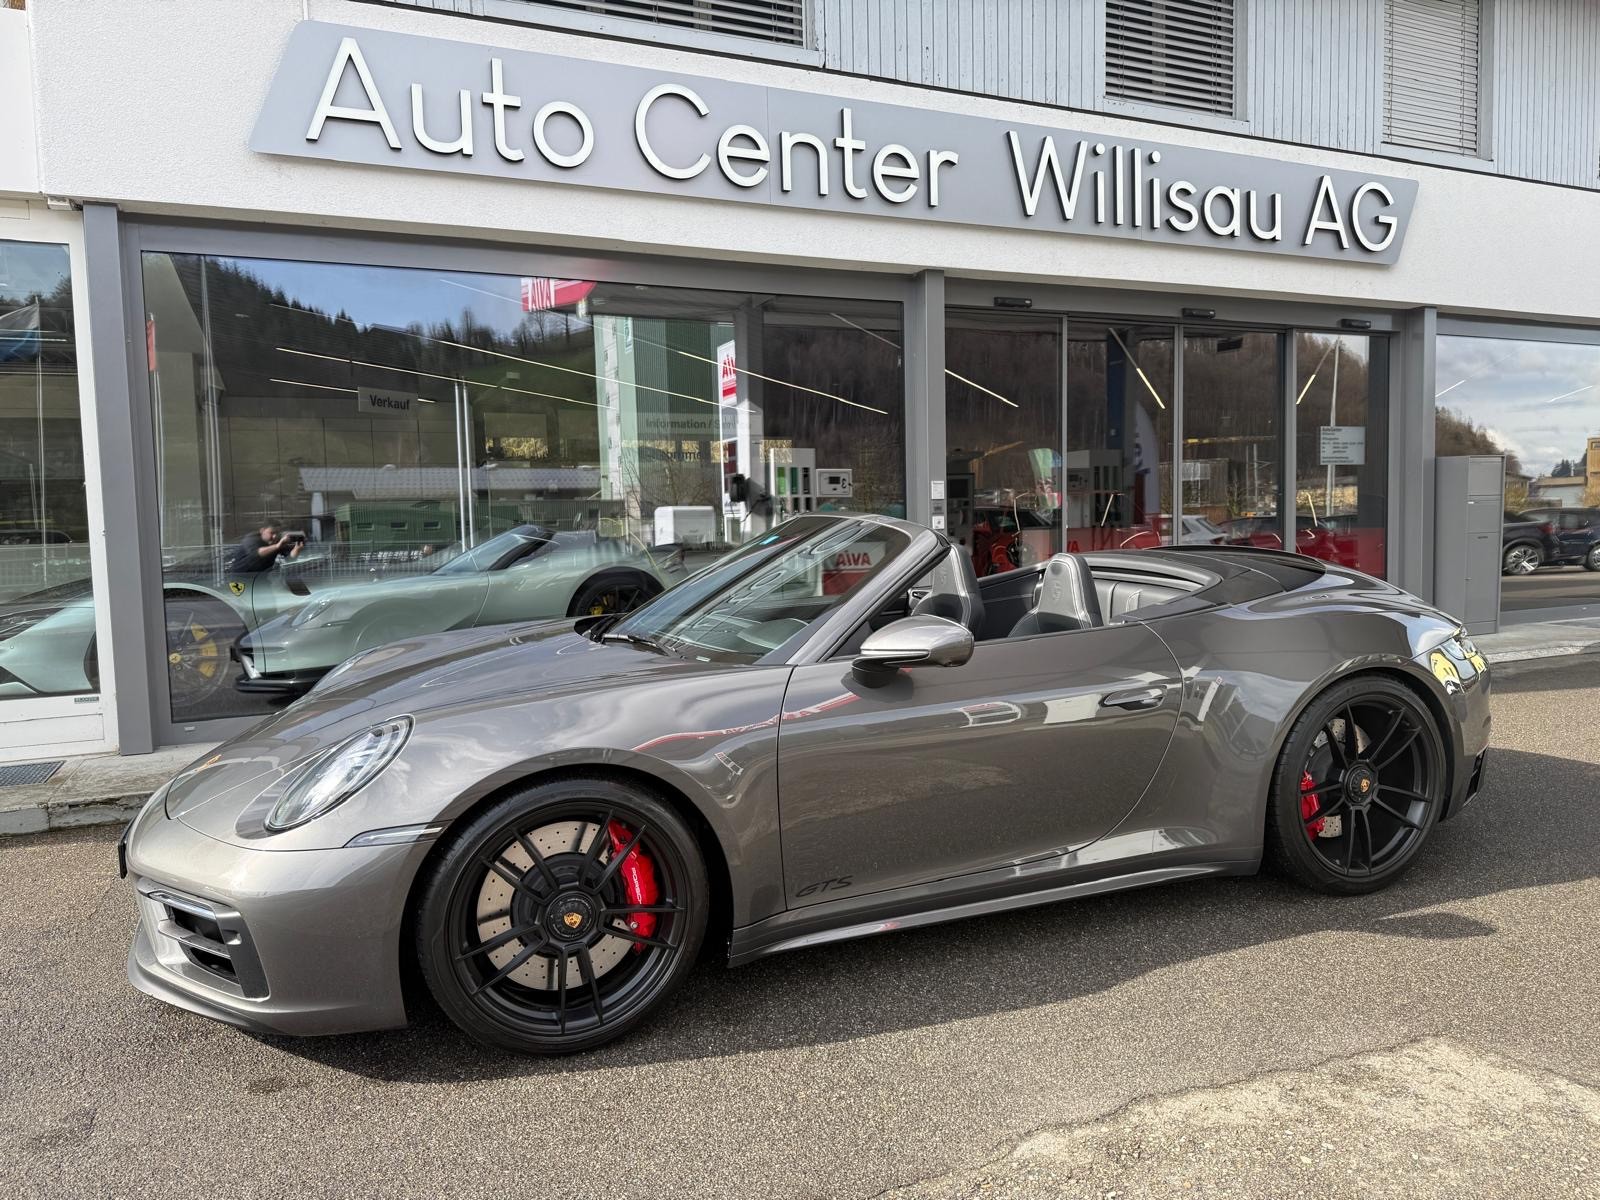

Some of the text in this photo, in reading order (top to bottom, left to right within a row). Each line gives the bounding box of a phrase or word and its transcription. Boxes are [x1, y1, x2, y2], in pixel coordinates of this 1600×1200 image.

[305, 37, 1399, 252] Auto Center Willisau AG
[369, 394, 410, 410] Verkauf
[646, 418, 706, 429] Information
[795, 875, 854, 898] GTS
